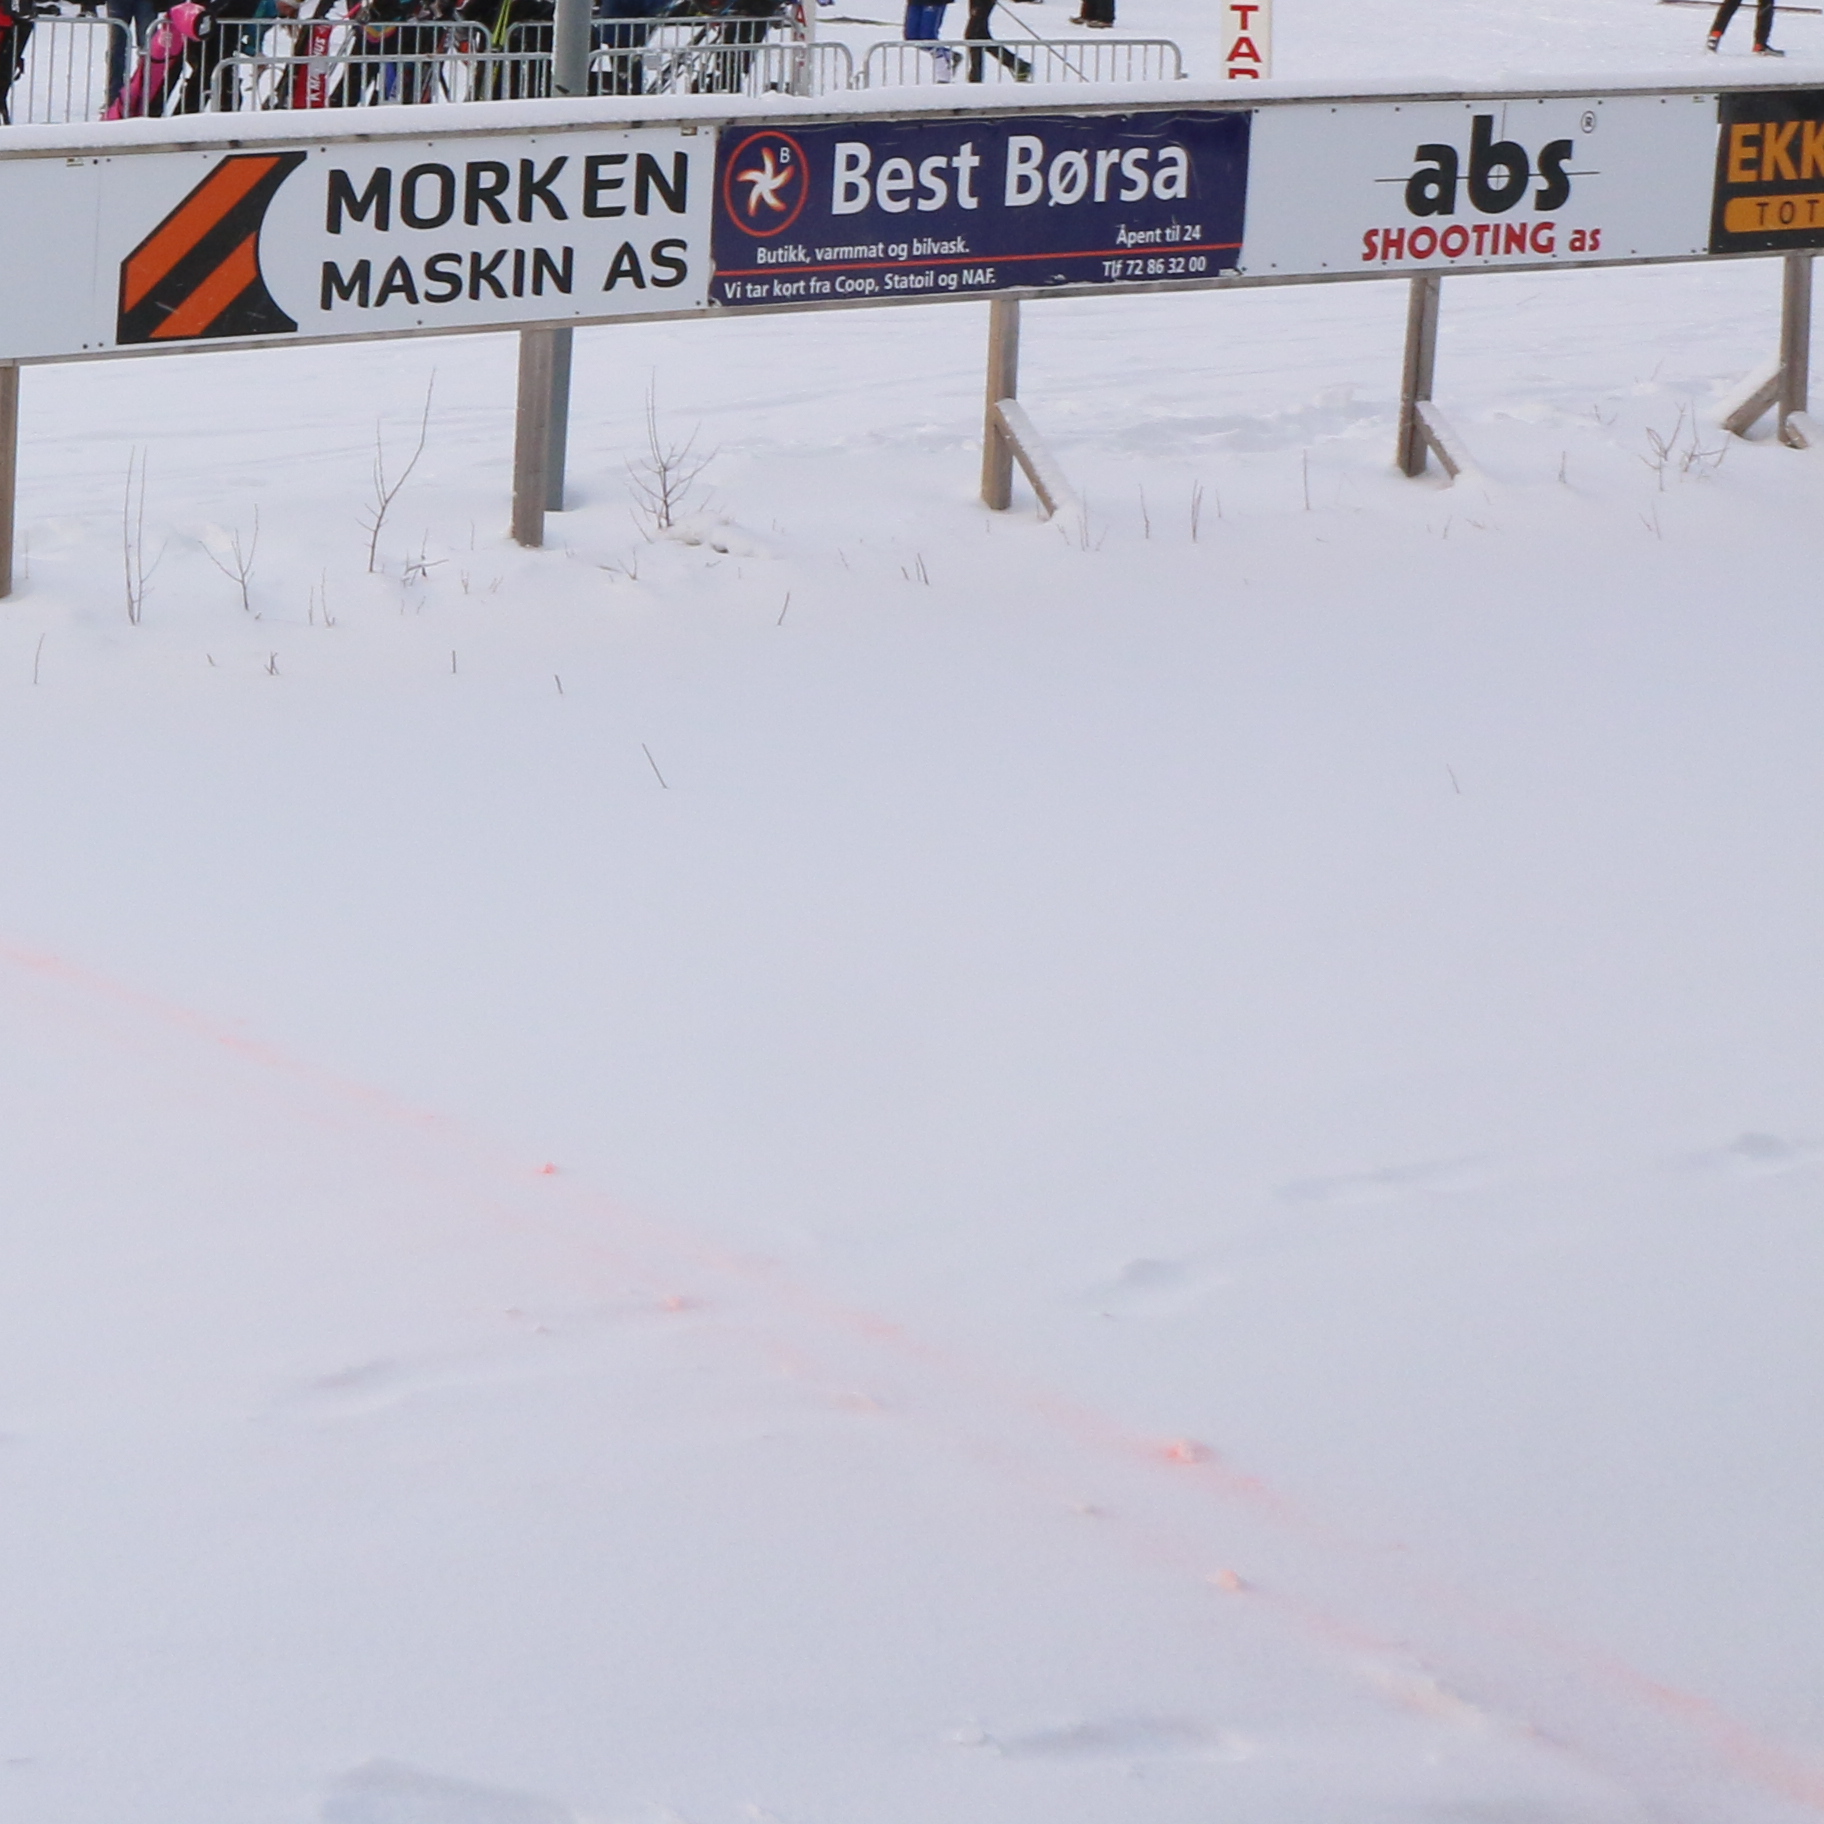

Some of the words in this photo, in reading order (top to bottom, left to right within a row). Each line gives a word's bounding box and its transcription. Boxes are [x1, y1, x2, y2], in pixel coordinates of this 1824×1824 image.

[832, 141, 980, 216] Best
[1004, 135, 1188, 208] Børsa
[1404, 115, 1573, 217] abs
[326, 151, 688, 236] MORKEN
[1756, 199, 1820, 226] TOT
[756, 245, 810, 264] Butikk,
[815, 242, 884, 261] varmmat
[888, 242, 908, 260] og
[913, 236, 969, 255] bilvask.
[1116, 224, 1162, 248] Åpent
[1165, 225, 1180, 242] til
[1183, 225, 1201, 241] 24
[1361, 221, 1554, 261] SHOOTING
[1568, 227, 1602, 253] as
[320, 246, 574, 311] MASKIN
[603, 238, 688, 292] AS
[724, 282, 741, 298] Vi
[746, 282, 769, 298] tar
[773, 280, 806, 297] kort
[809, 277, 830, 294] fra
[835, 275, 879, 294] Coop,
[884, 270, 933, 290] Statoil
[938, 272, 958, 290] og
[962, 268, 996, 285] NAF.
[1103, 259, 1122, 277] Tlf
[1126, 260, 1143, 275] 72
[1147, 258, 1165, 274] 86
[1168, 257, 1185, 273] 32
[1189, 256, 1206, 272] 00
